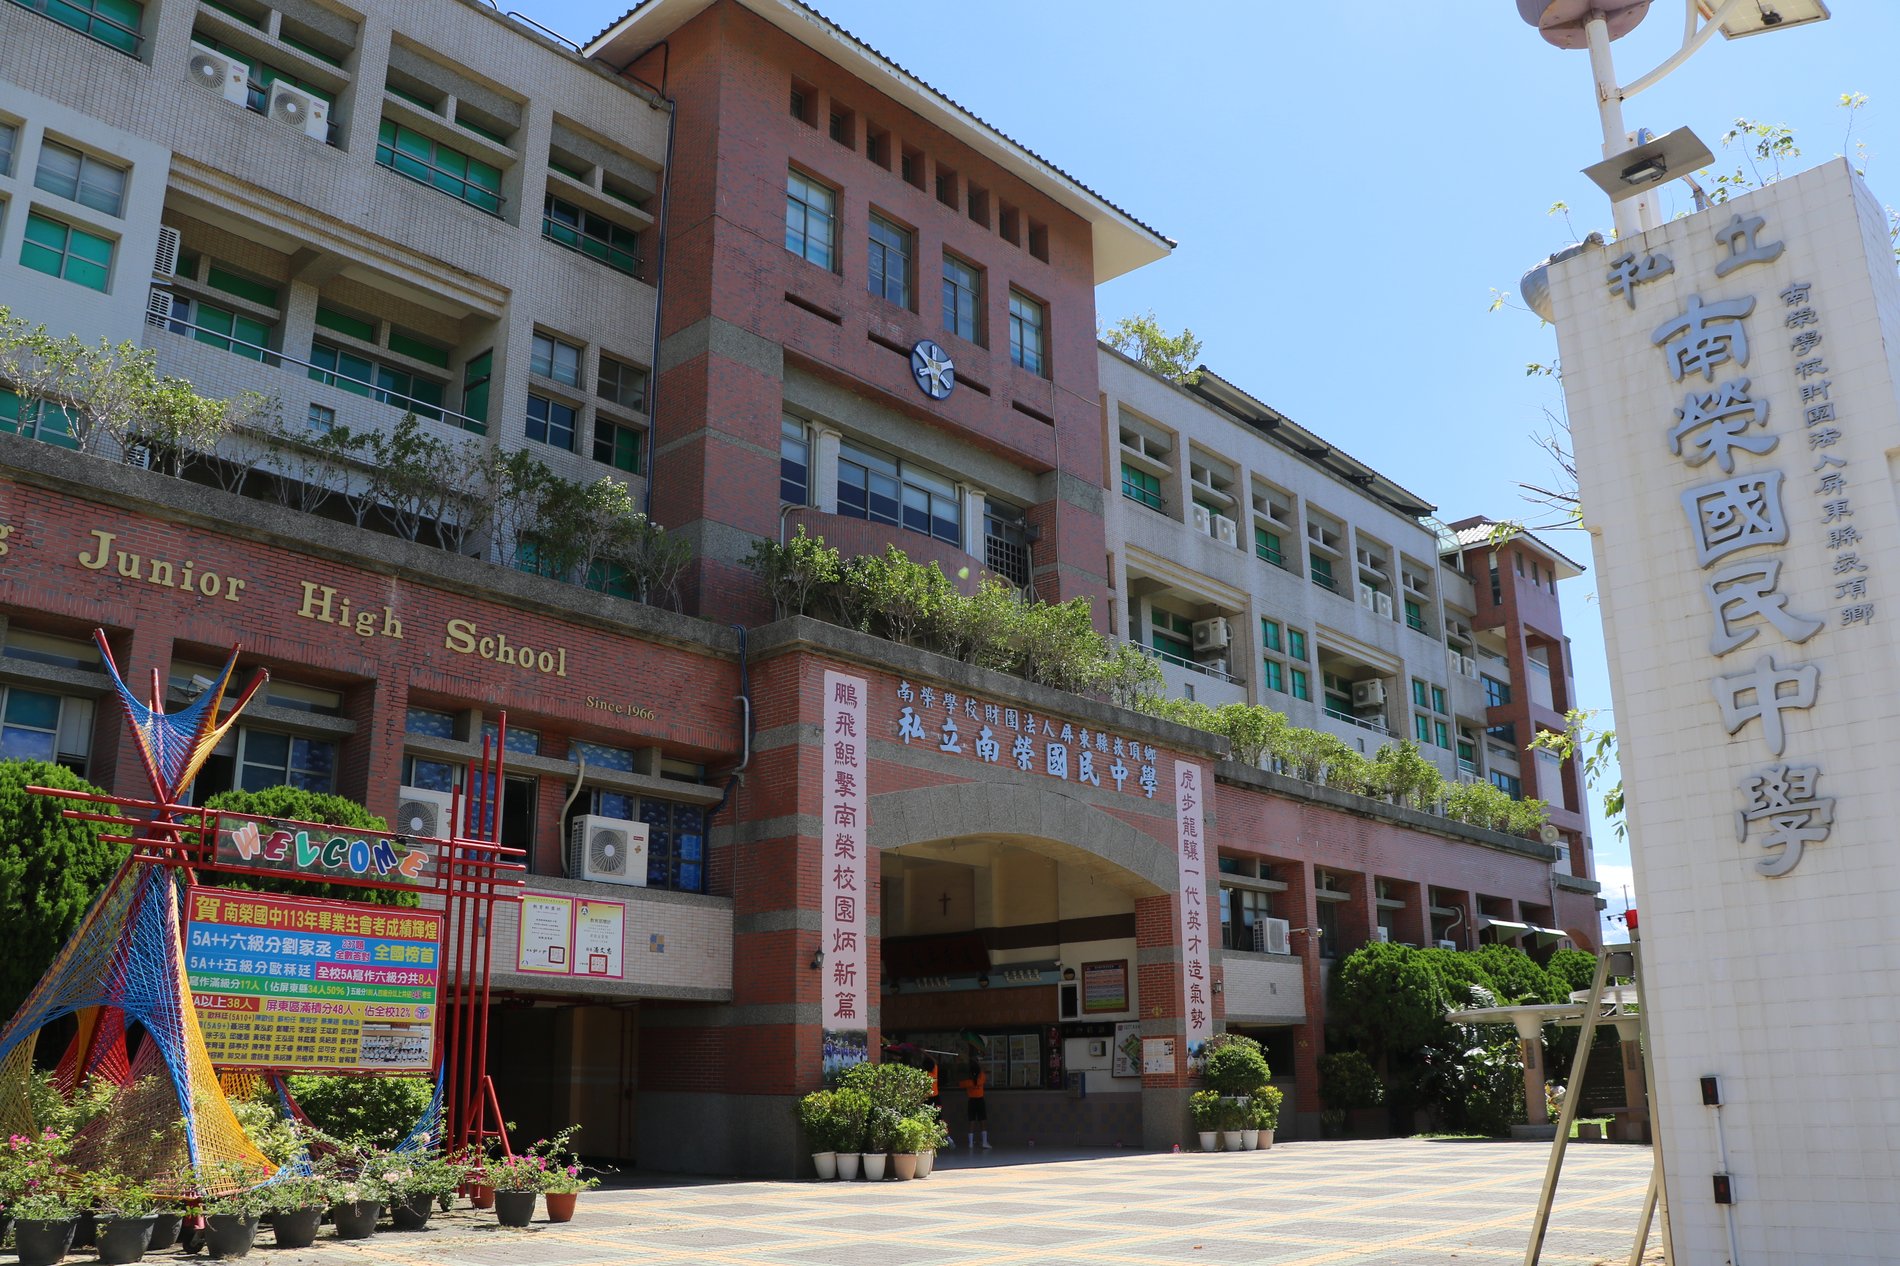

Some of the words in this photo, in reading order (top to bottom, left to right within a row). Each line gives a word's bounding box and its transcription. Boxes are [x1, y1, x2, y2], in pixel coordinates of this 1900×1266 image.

[78, 529, 245, 602] Junior
[297, 580, 404, 640] High
[445, 617, 567, 677] School
[586, 695, 622, 713] Since
[627, 704, 655, 720] 1966
[897, 680, 1158, 762] 南榮學校財團法人屏東縣崁頂鄉
[898, 706, 1159, 799] 私立南榮國民中學
[232, 821, 429, 878] WELCOME
[196, 895, 220, 923] 賀
[1180, 768, 1205, 1029] 虎步龍驤一代英才造氣勢
[374, 943, 435, 964] 全國榜首
